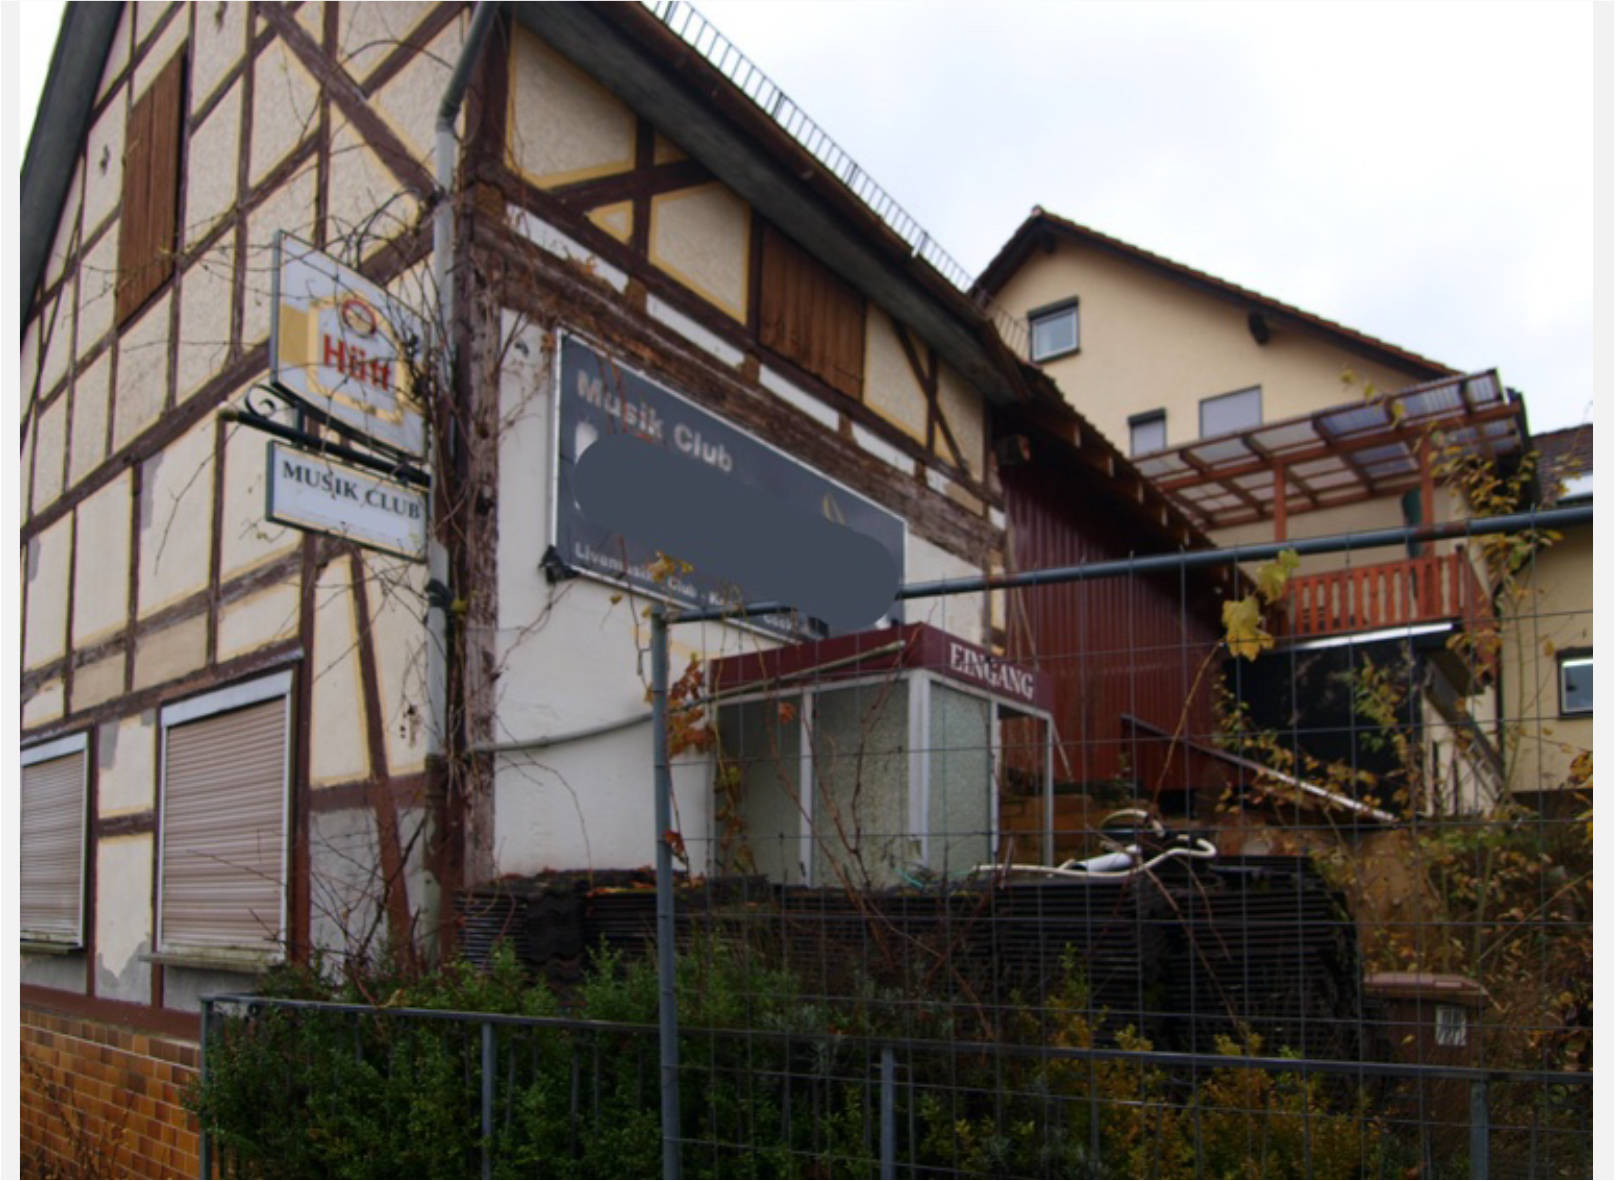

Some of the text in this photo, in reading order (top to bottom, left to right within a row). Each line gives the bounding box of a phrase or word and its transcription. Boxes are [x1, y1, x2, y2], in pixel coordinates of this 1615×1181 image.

[323, 333, 391, 392] Hütt
[576, 369, 733, 472] Musik Club
[282, 460, 421, 519] MUSIK CLUB
[950, 642, 1034, 700] EINGANG
